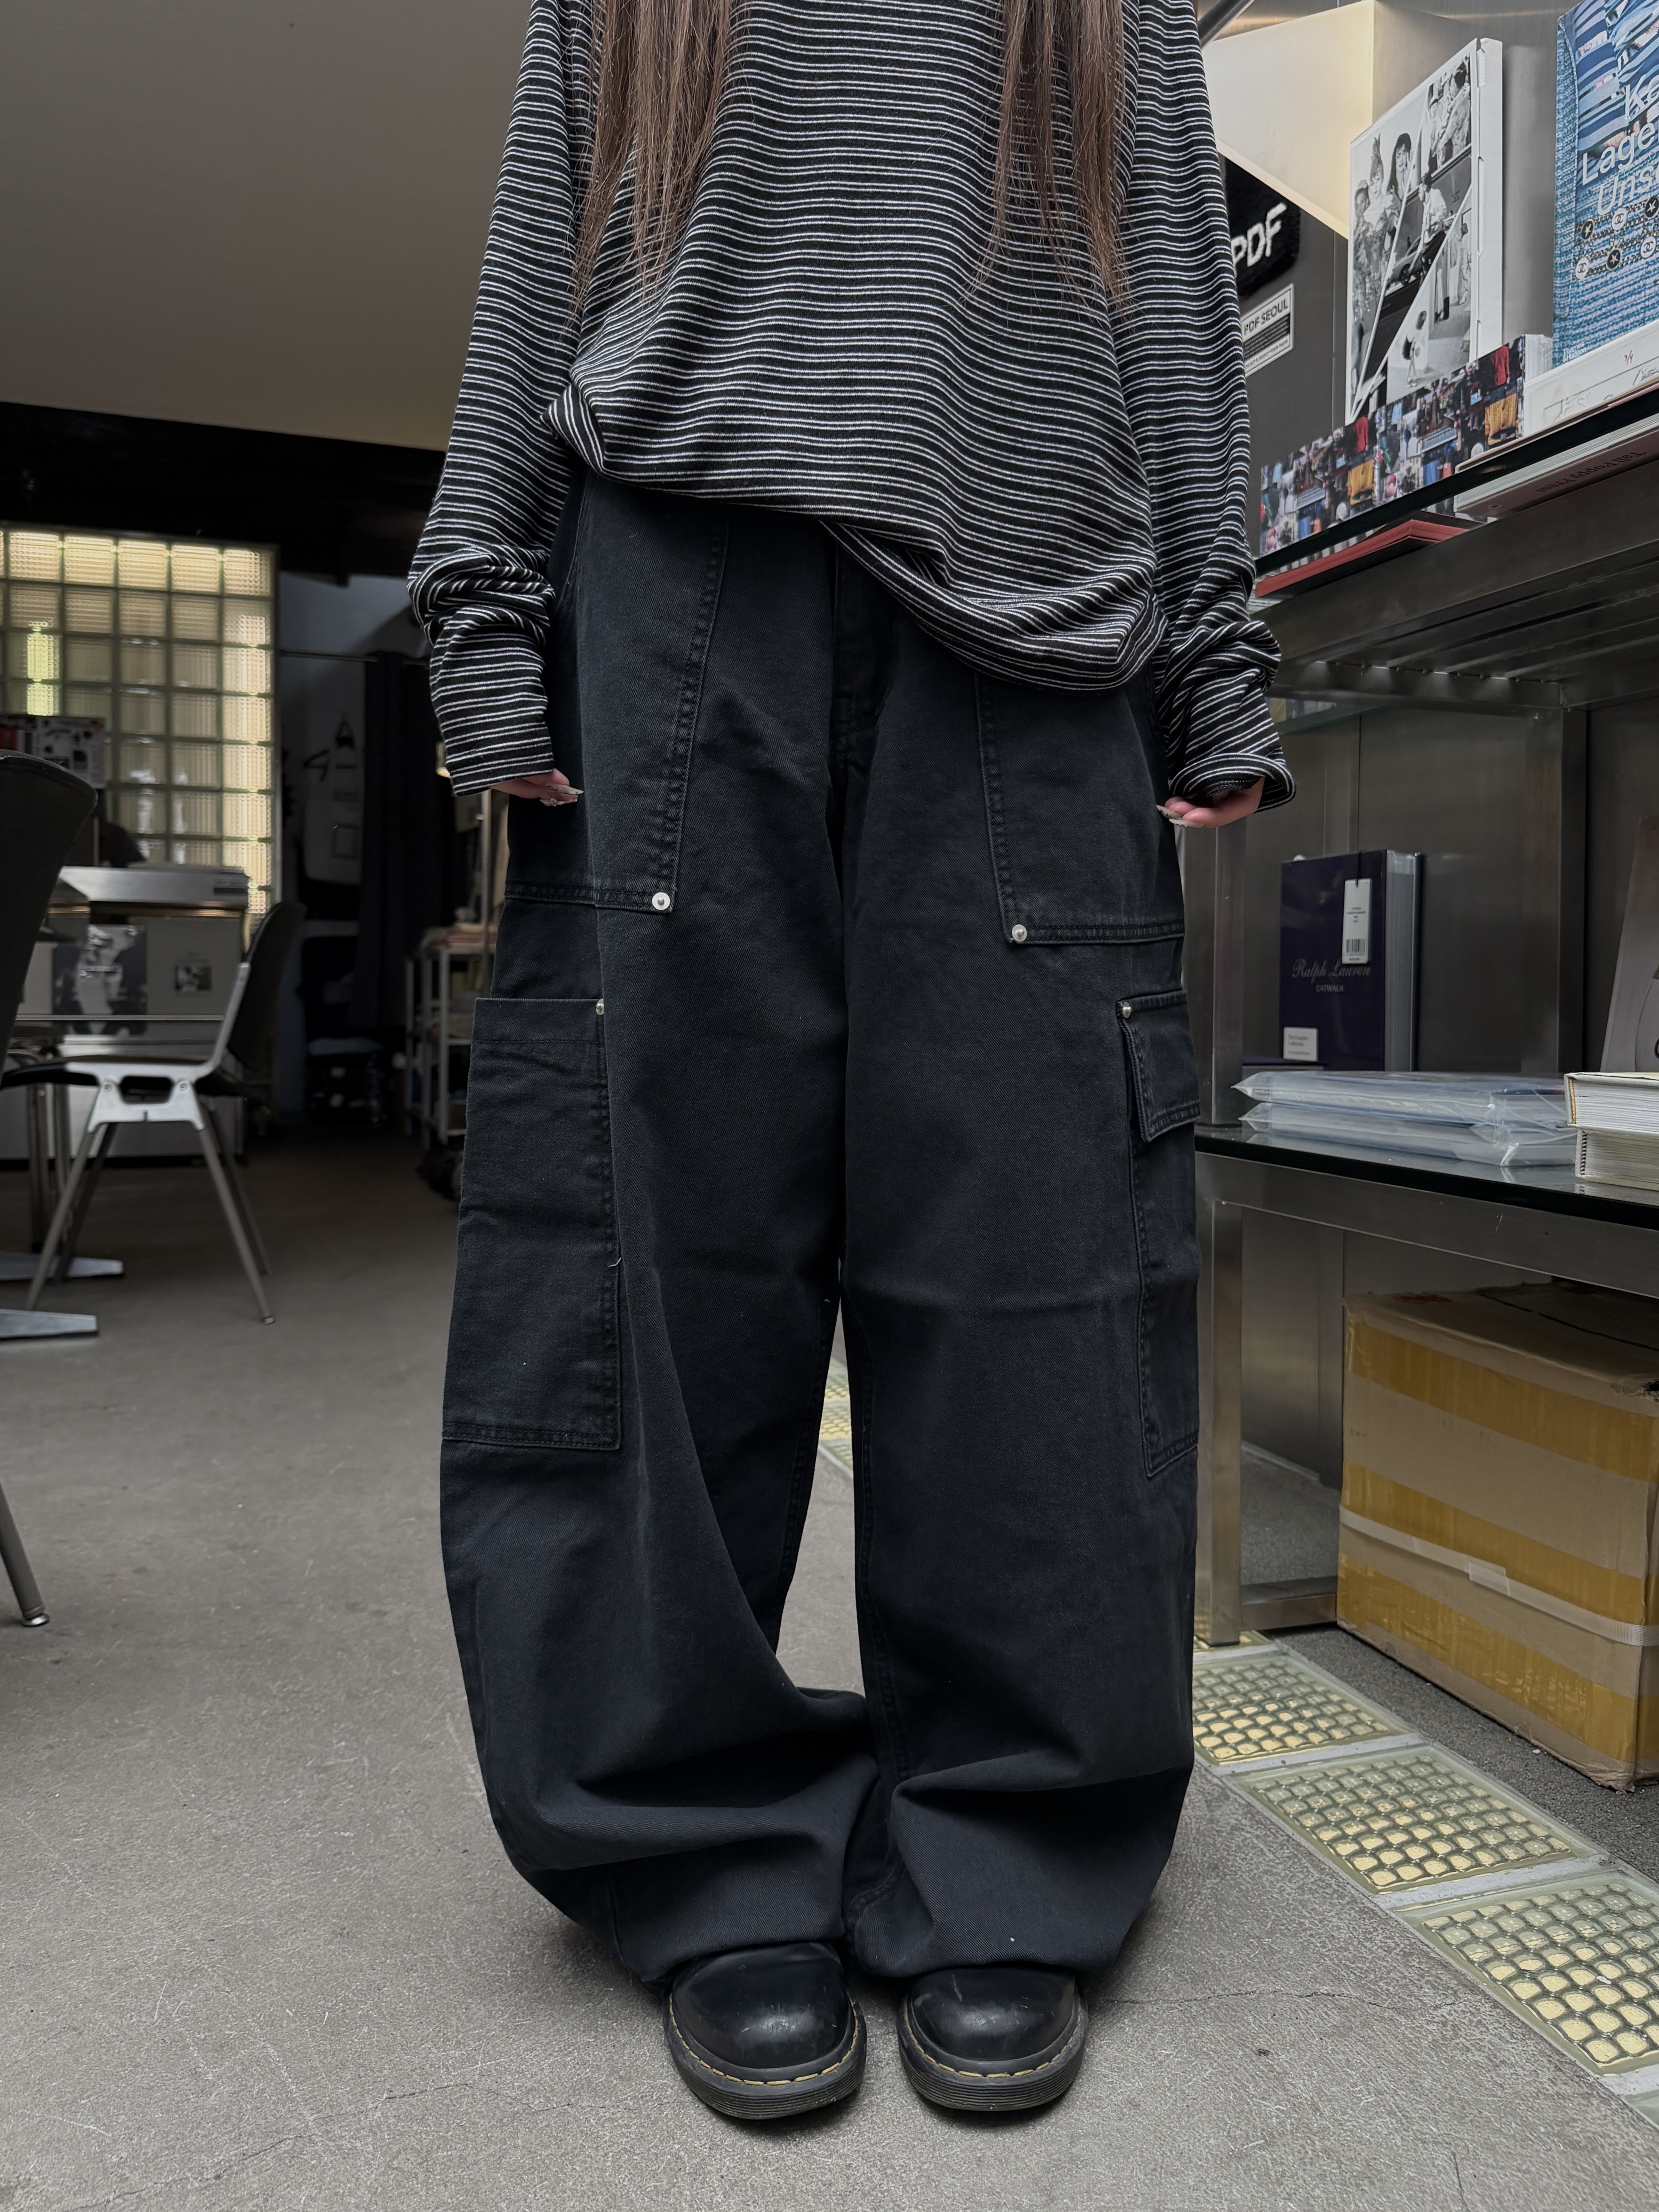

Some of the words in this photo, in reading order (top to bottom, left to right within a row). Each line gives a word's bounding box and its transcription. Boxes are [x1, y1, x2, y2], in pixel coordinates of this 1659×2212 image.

[1582, 118, 1659, 186] Lage
[1597, 163, 1659, 215] Uns
[1231, 202, 1287, 278] PDF
[1244, 316, 1260, 336] PDF
[1261, 299, 1288, 325] SEOUL
[1613, 452, 1646, 463] Tall
[1570, 462, 1617, 479] Poppy
[1535, 478, 1575, 492] Press
[1292, 958, 1327, 983] Ralph
[1328, 959, 1371, 977] Lauren
[1315, 984, 1344, 993] CATWALK
